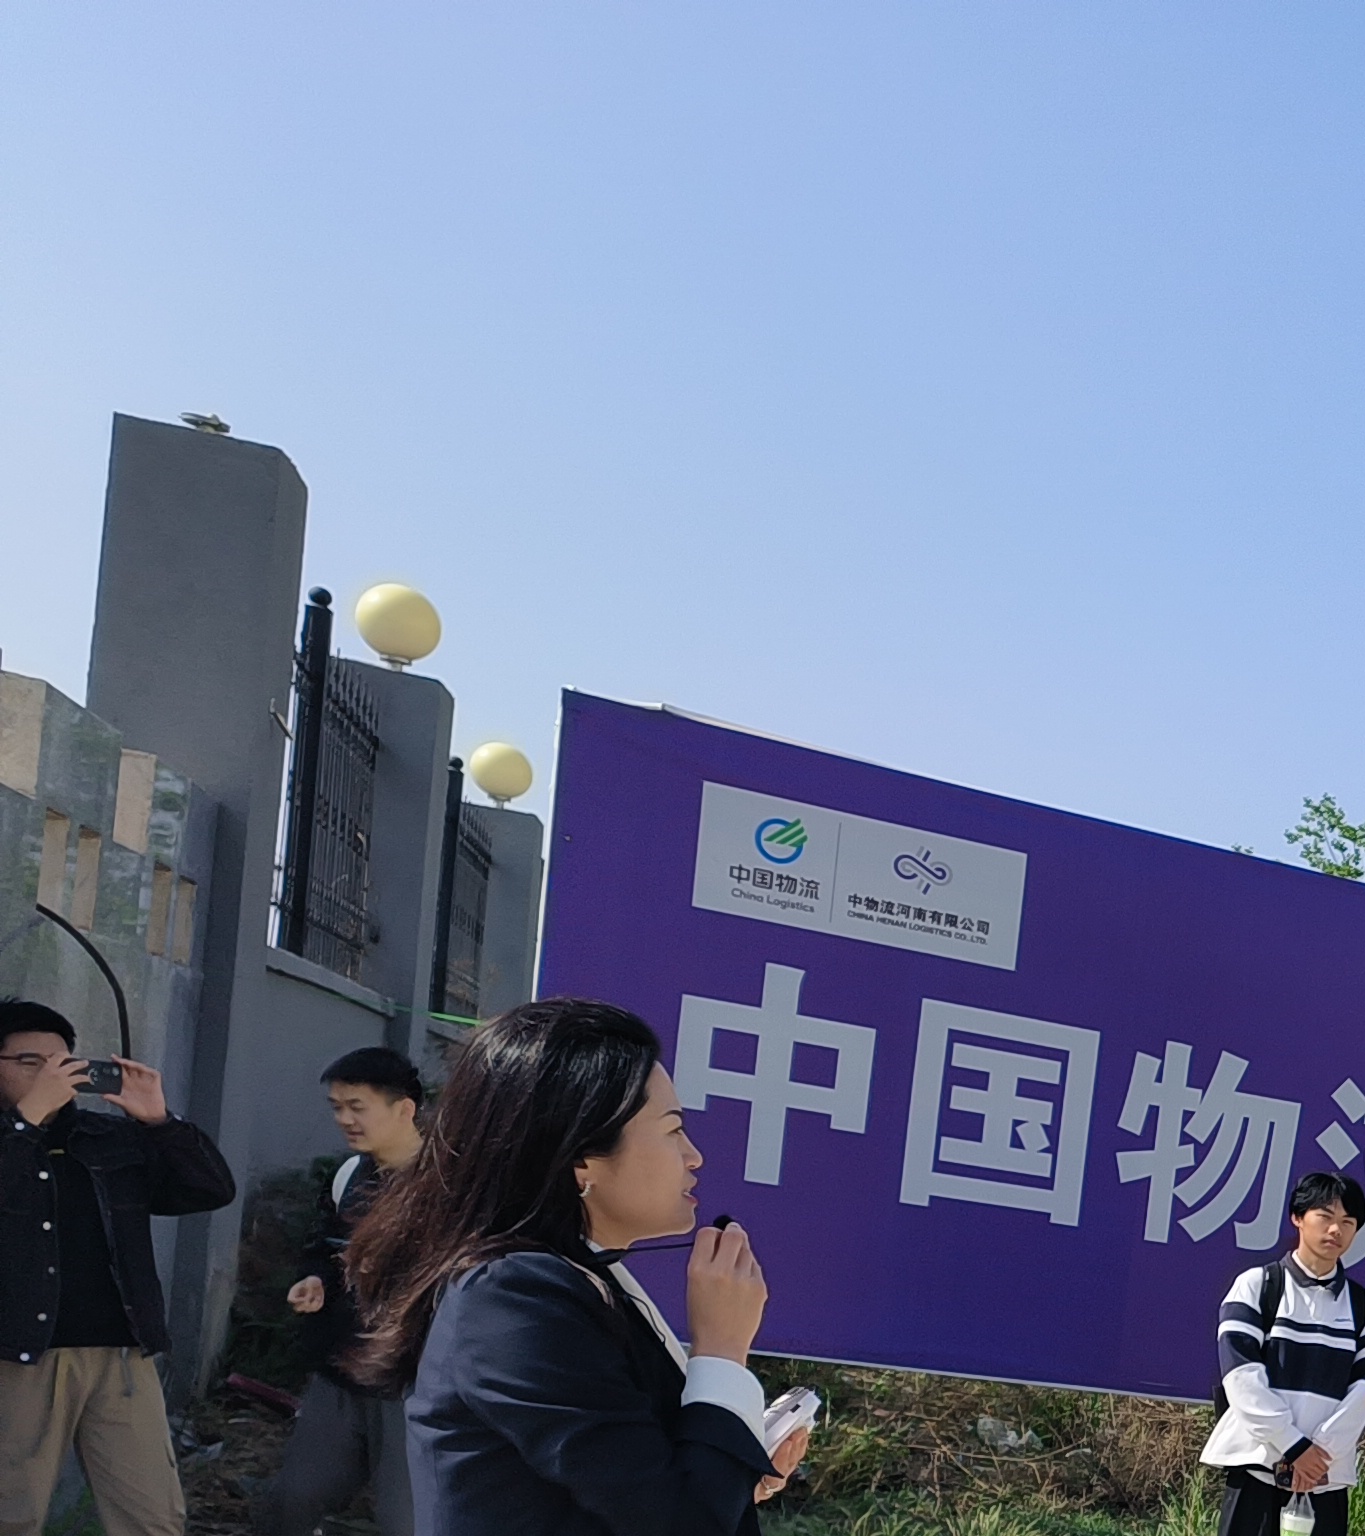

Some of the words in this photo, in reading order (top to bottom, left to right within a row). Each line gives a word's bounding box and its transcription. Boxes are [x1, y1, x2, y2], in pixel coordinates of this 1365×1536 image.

[729, 864, 820, 900] 中国物流
[731, 887, 763, 903] China
[766, 895, 815, 913] Logistics
[847, 893, 990, 935] 中物流河南有限公司
[847, 910, 875, 922] CHINA
[876, 916, 907, 929] HENAN
[909, 922, 952, 938] LOGISTICS
